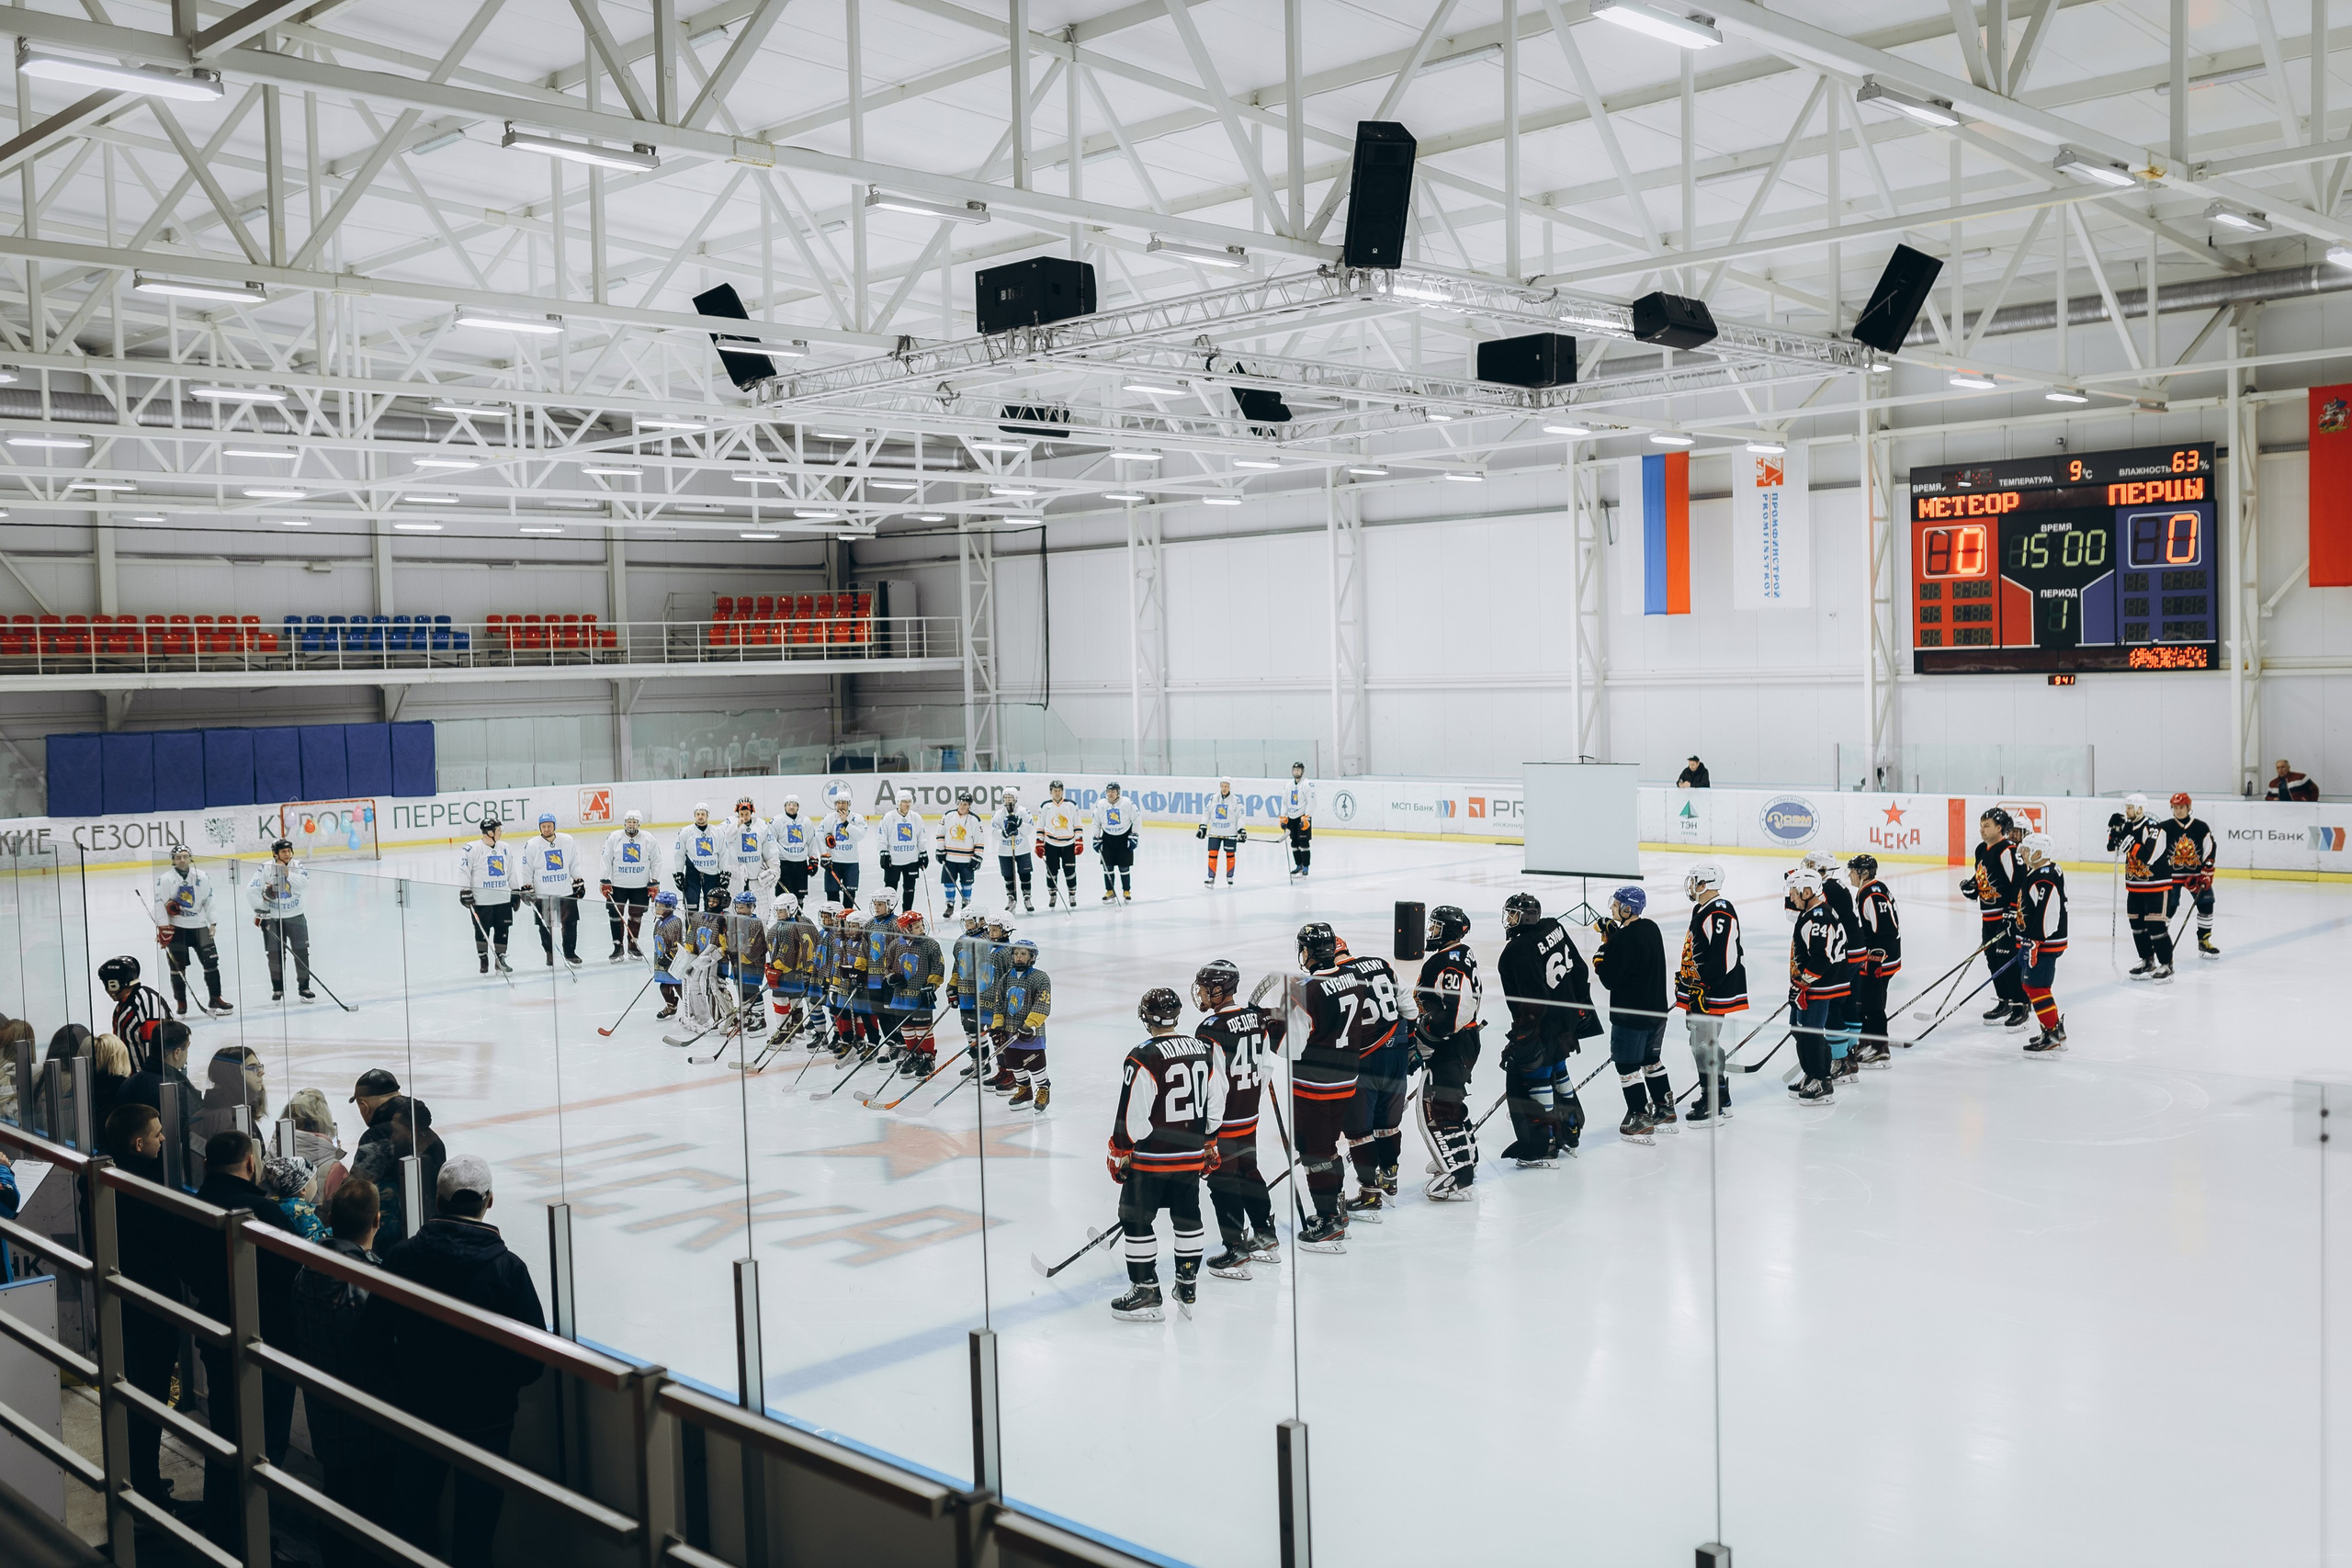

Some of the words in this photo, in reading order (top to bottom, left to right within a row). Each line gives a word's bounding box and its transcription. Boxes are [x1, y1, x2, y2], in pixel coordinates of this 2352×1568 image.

[2070, 460, 2083, 481] 9
[2172, 450, 2199, 473] 63
[2119, 466, 2172, 477] ВЛАЖНОСТЬ
[1998, 476, 2053, 487] ТЕМПЕРАТУРА
[2108, 478, 2204, 506] ПЕРЦЫ
[1918, 491, 2019, 519] МЕТЕОР
[2041, 523, 2073, 533] ВРЕМЯ
[1762, 493, 1770, 598] PROMFINSTROY
[1771, 492, 1781, 598] ПРОМФИНСТРОЙ
[2166, 513, 2198, 564] 0
[2041, 588, 2078, 598] ПЕРИОД
[393, 798, 530, 829] ПЕРЕСВЕТ
[1391, 802, 1411, 811] МСП
[1413, 802, 1434, 812] Банк
[1679, 821, 1698, 830] ТЭН
[73, 820, 185, 852] СЕЗОНЫ
[1869, 827, 1921, 851] ЦСКА
[2228, 829, 2264, 840] МСП
[2268, 829, 2304, 841] Банк
[618, 865, 645, 874] МЕТЕОР
[1715, 919, 1724, 934] 5
[1812, 923, 1827, 938] 24
[1444, 974, 1460, 990] 30
[1165, 1060, 1209, 1122] 20
